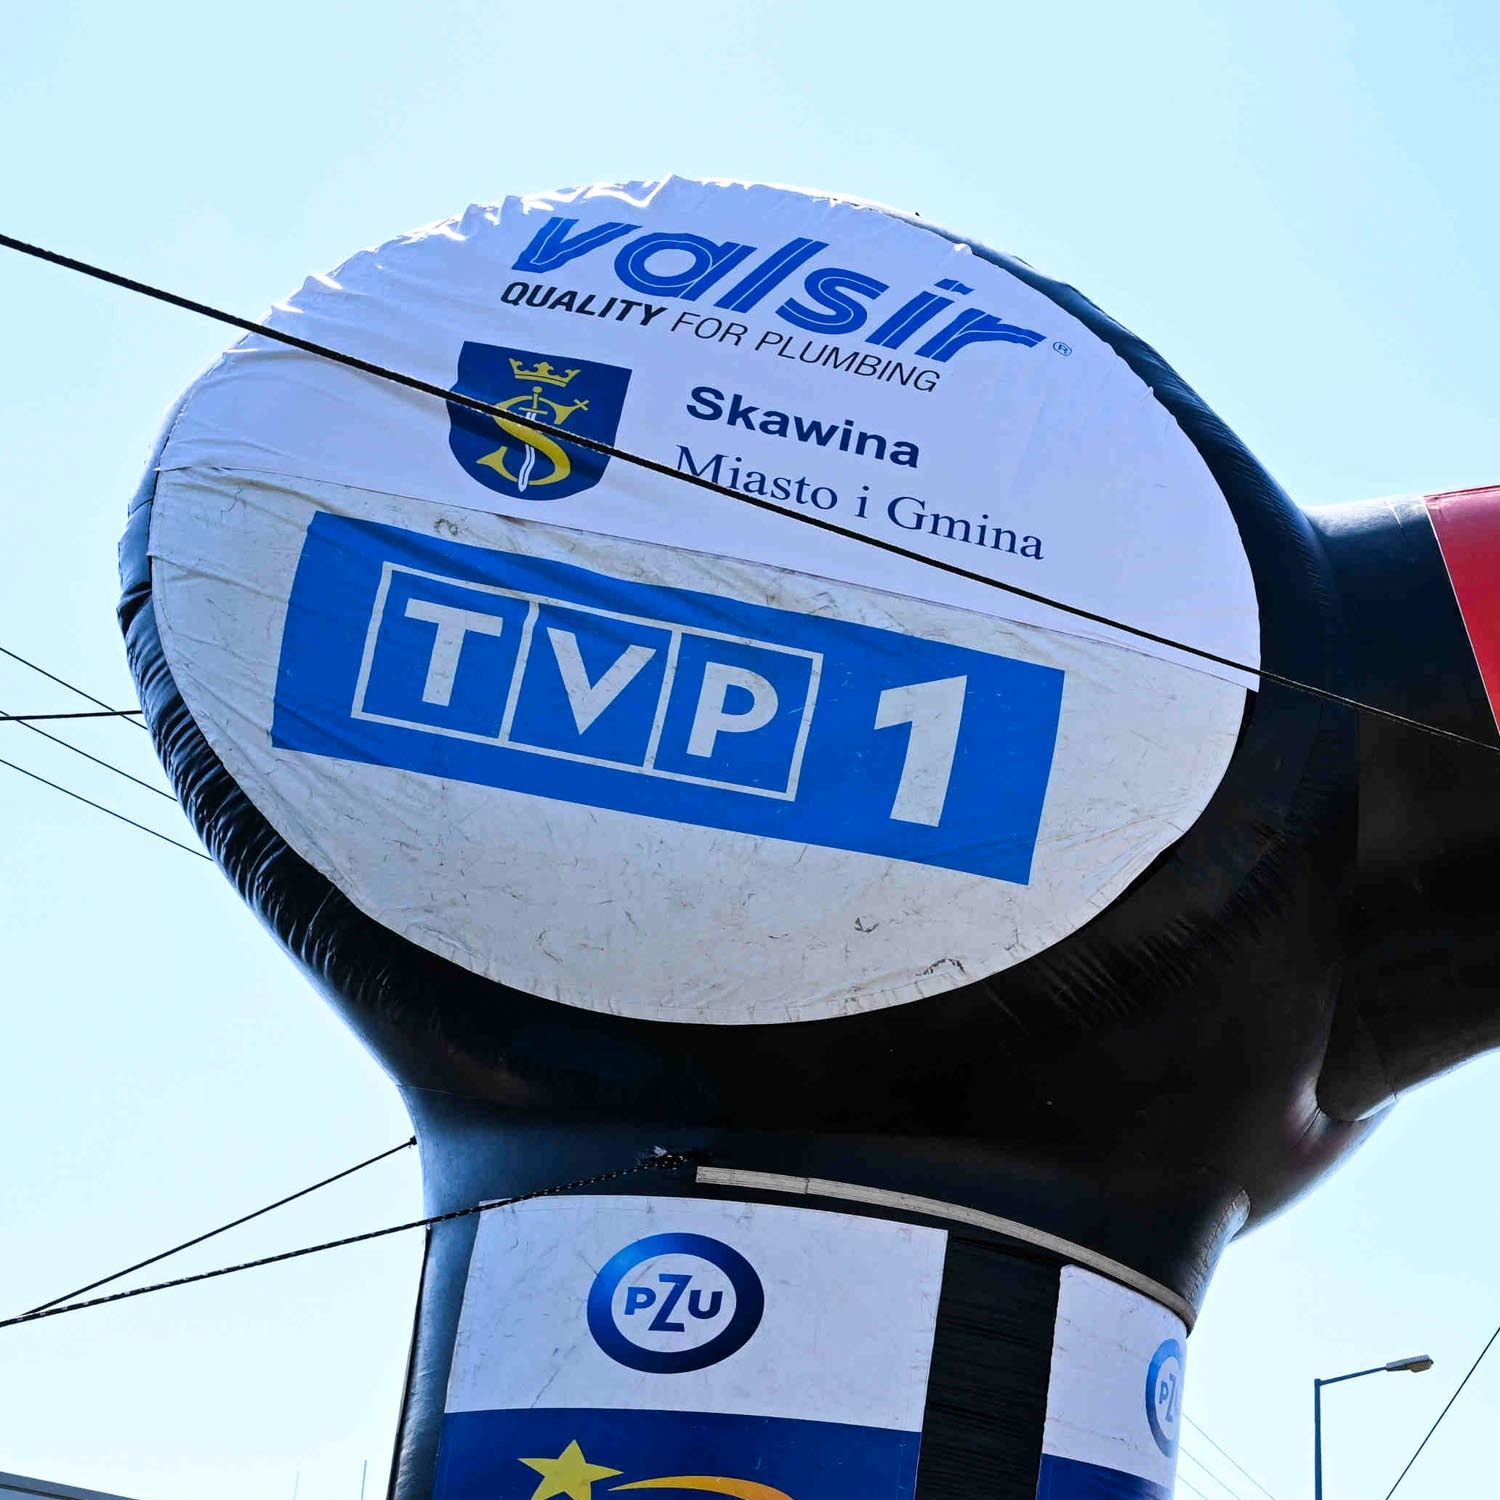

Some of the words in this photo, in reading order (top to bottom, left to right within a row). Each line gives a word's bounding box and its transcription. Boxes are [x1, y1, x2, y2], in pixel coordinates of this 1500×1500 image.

[500, 281, 667, 328] QUALITY
[671, 311, 749, 349] FOR
[753, 325, 940, 394] PLUMBING
[510, 216, 1046, 364] valsir
[687, 384, 921, 469] Skawina
[674, 445, 841, 514] Miasto
[855, 482, 869, 518] i
[886, 493, 1044, 563] Gmina
[404, 598, 778, 759] TVP
[874, 675, 966, 828] 1
[624, 1272, 724, 1333] PZU
